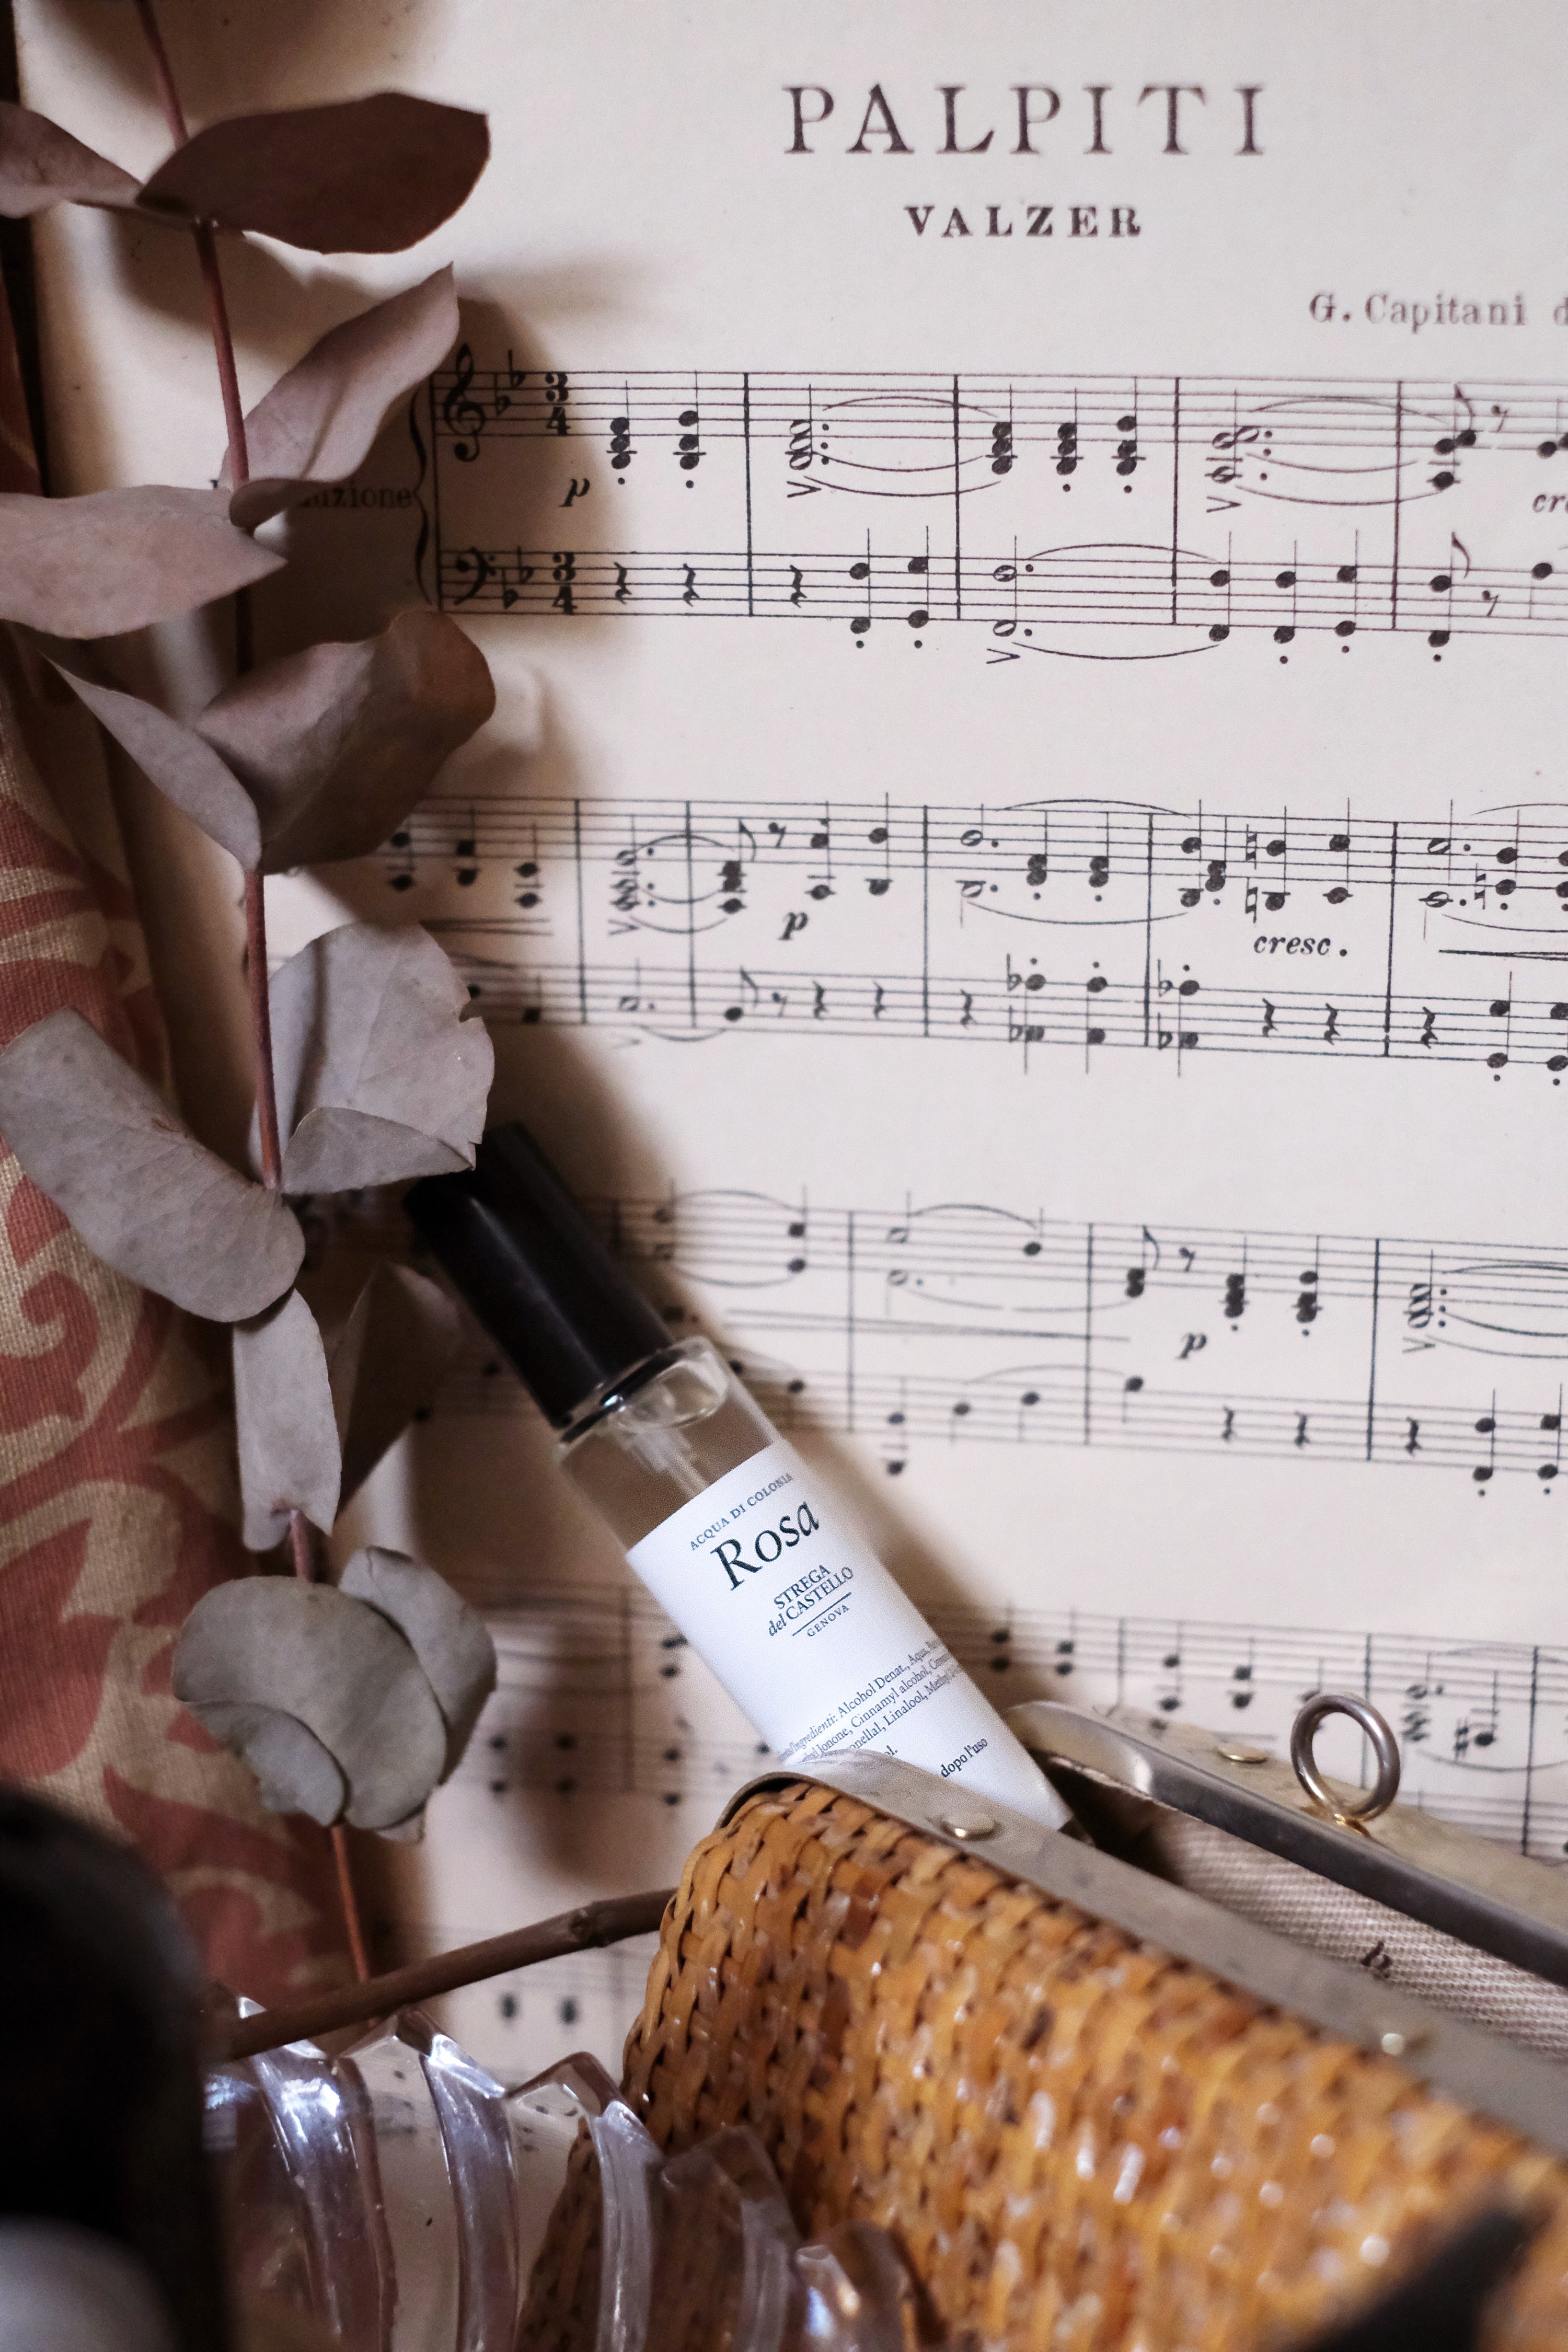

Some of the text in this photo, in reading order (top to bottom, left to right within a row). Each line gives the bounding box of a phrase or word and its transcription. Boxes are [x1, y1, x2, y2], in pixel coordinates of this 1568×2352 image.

[782, 83, 1265, 156] PALPITI
[904, 206, 1142, 238] VALZER
[1308, 292, 1352, 323] G.
[1364, 292, 1526, 335] Capitani
[1532, 493, 1568, 514] cr
[1253, 935, 1348, 957] cresc.
[689, 1472, 793, 1551] ACQUA DI COLONIA
[710, 1501, 820, 1590] Rosa
[768, 1566, 854, 1636] del CASTELLO
[773, 1564, 832, 1609] STREGA
[806, 1604, 850, 1637] GENOVA
[837, 1682, 877, 1718] Alcohol
[850, 1687, 900, 1728] Cinnamyl
[899, 1665, 932, 1693] alcohol,
[883, 1690, 928, 1726] Linalool,
[940, 1754, 968, 1778] dopo
